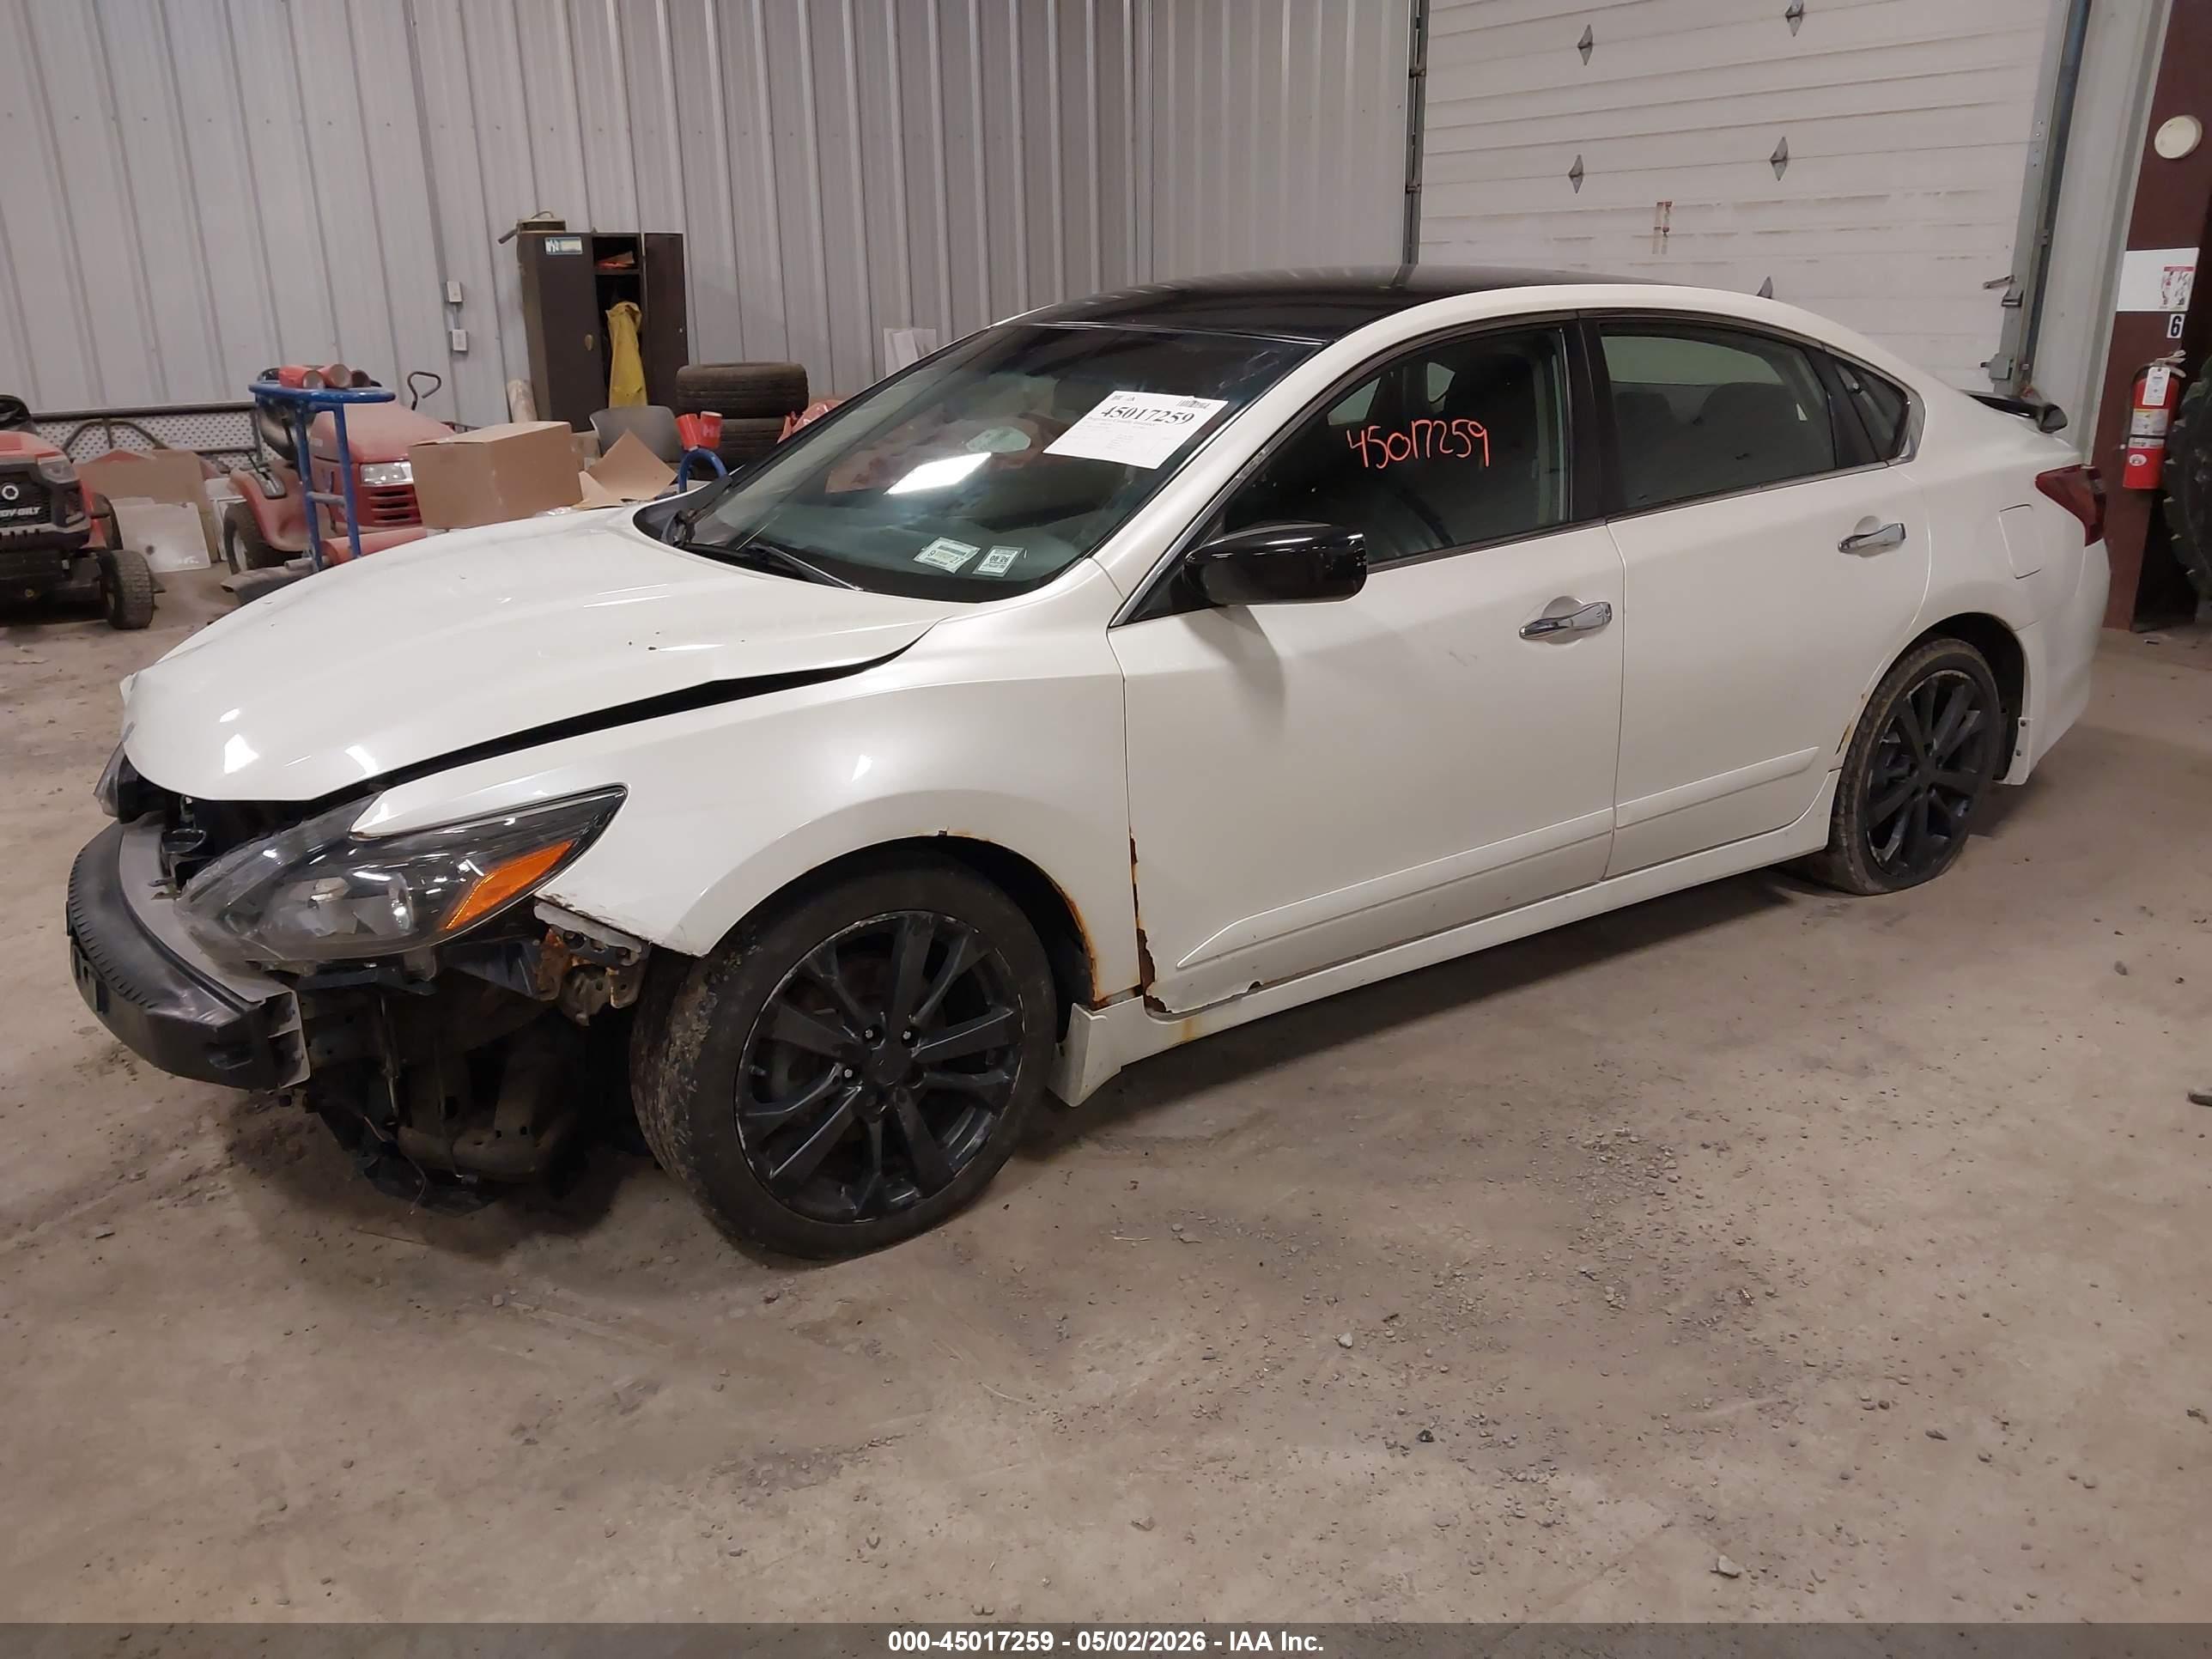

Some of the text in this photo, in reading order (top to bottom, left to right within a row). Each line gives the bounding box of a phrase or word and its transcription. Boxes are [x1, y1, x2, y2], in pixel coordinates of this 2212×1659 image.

[2170, 315, 2182, 337] 6
[1101, 405, 1195, 425] 45017259
[1346, 419, 1490, 469] 45017259
